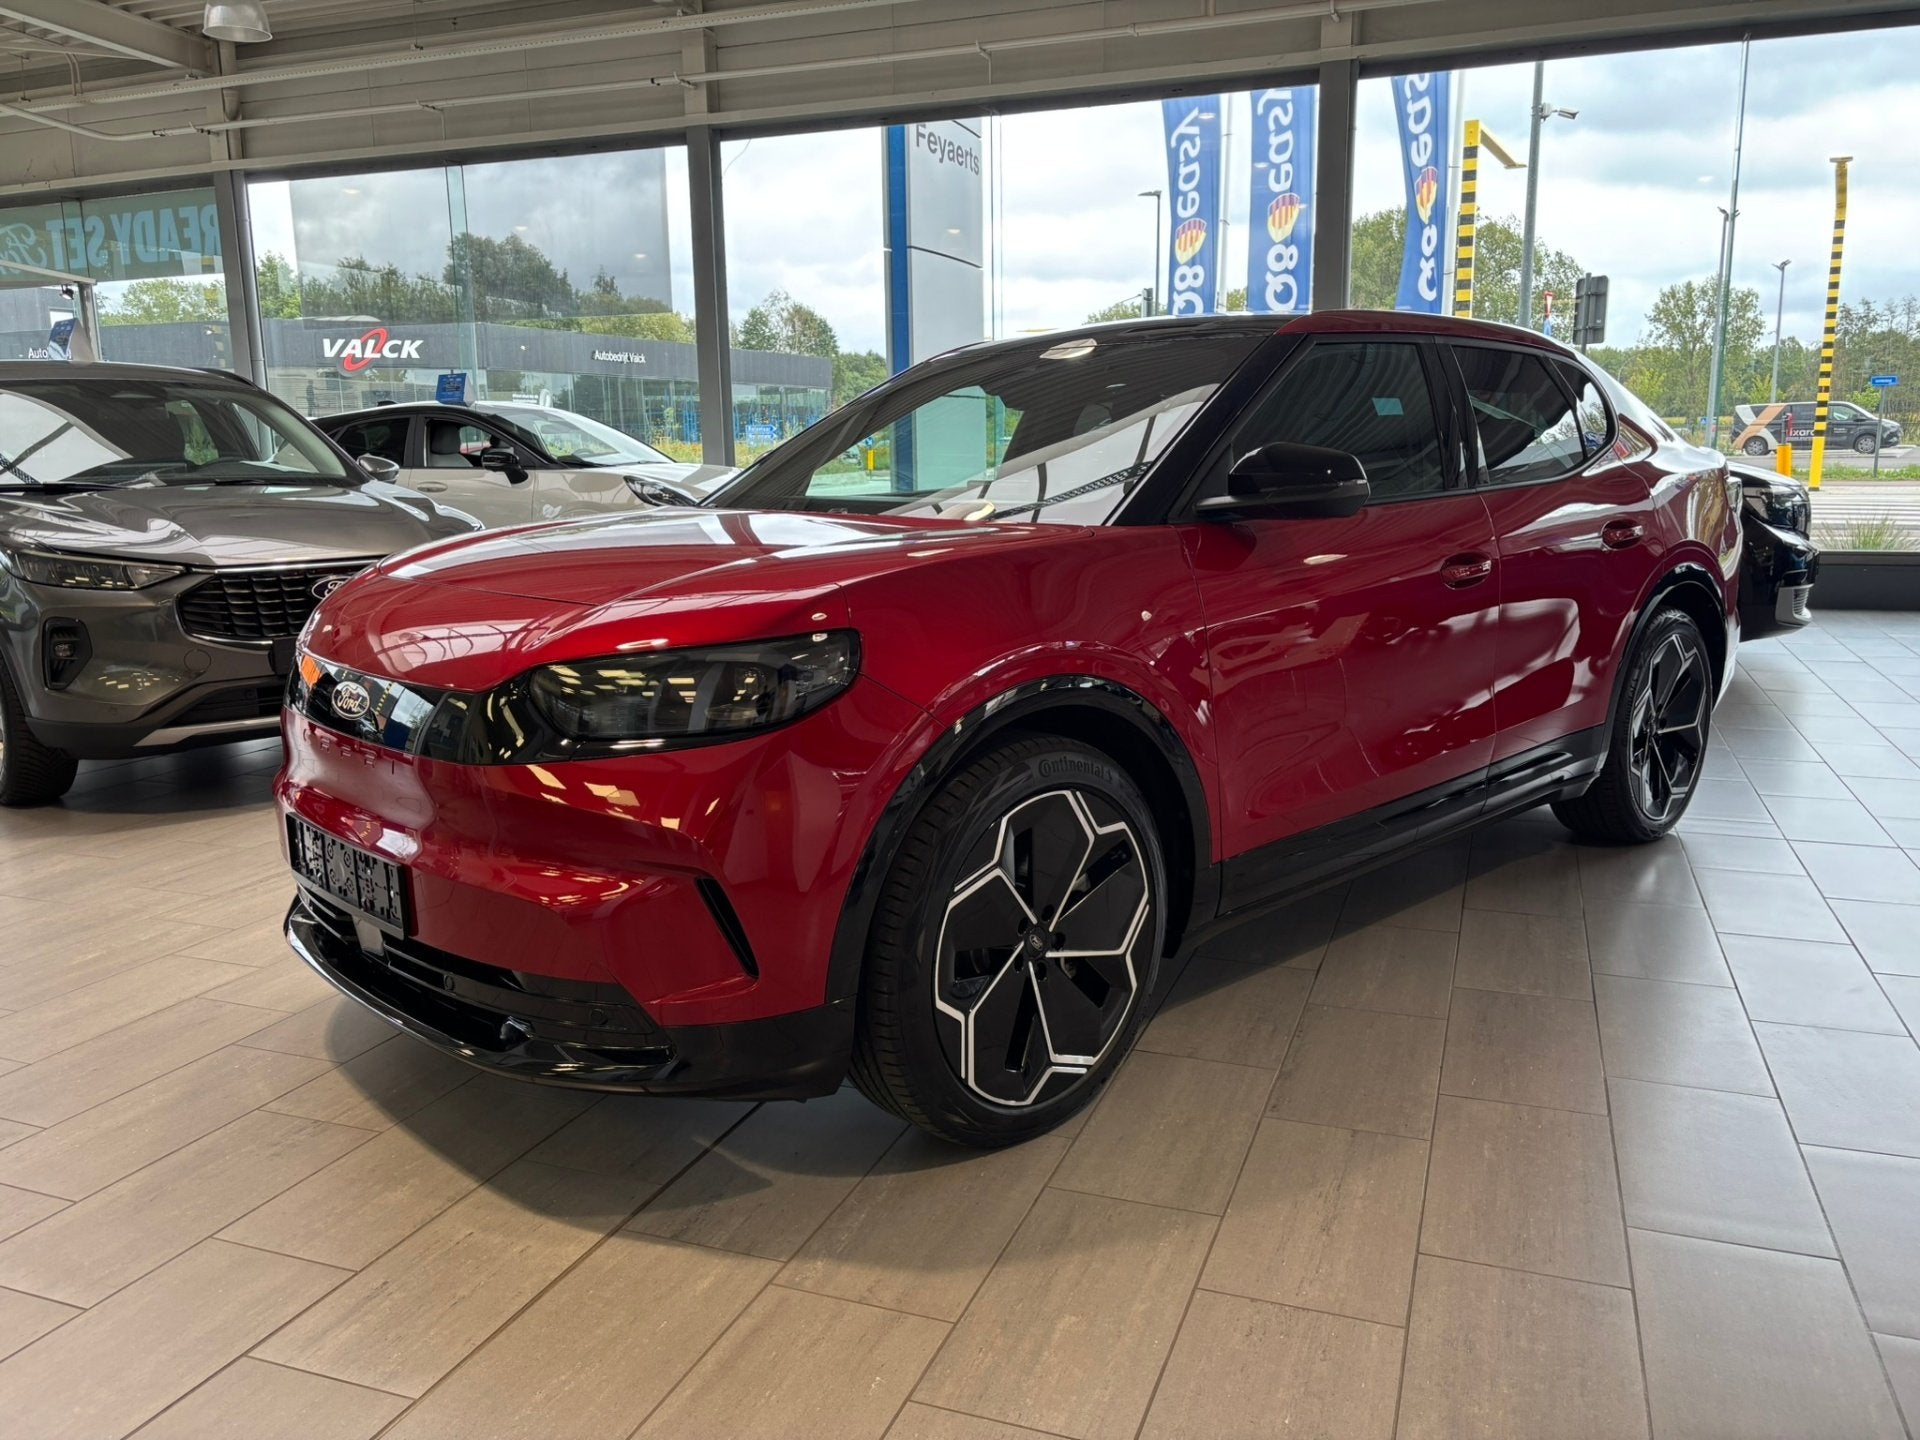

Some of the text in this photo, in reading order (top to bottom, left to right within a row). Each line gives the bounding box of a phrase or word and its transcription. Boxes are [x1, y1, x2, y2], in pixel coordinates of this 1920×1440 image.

[915, 122, 980, 177] Feyaerts
[321, 338, 425, 360] VALCK
[1038, 756, 1105, 779] Continental
